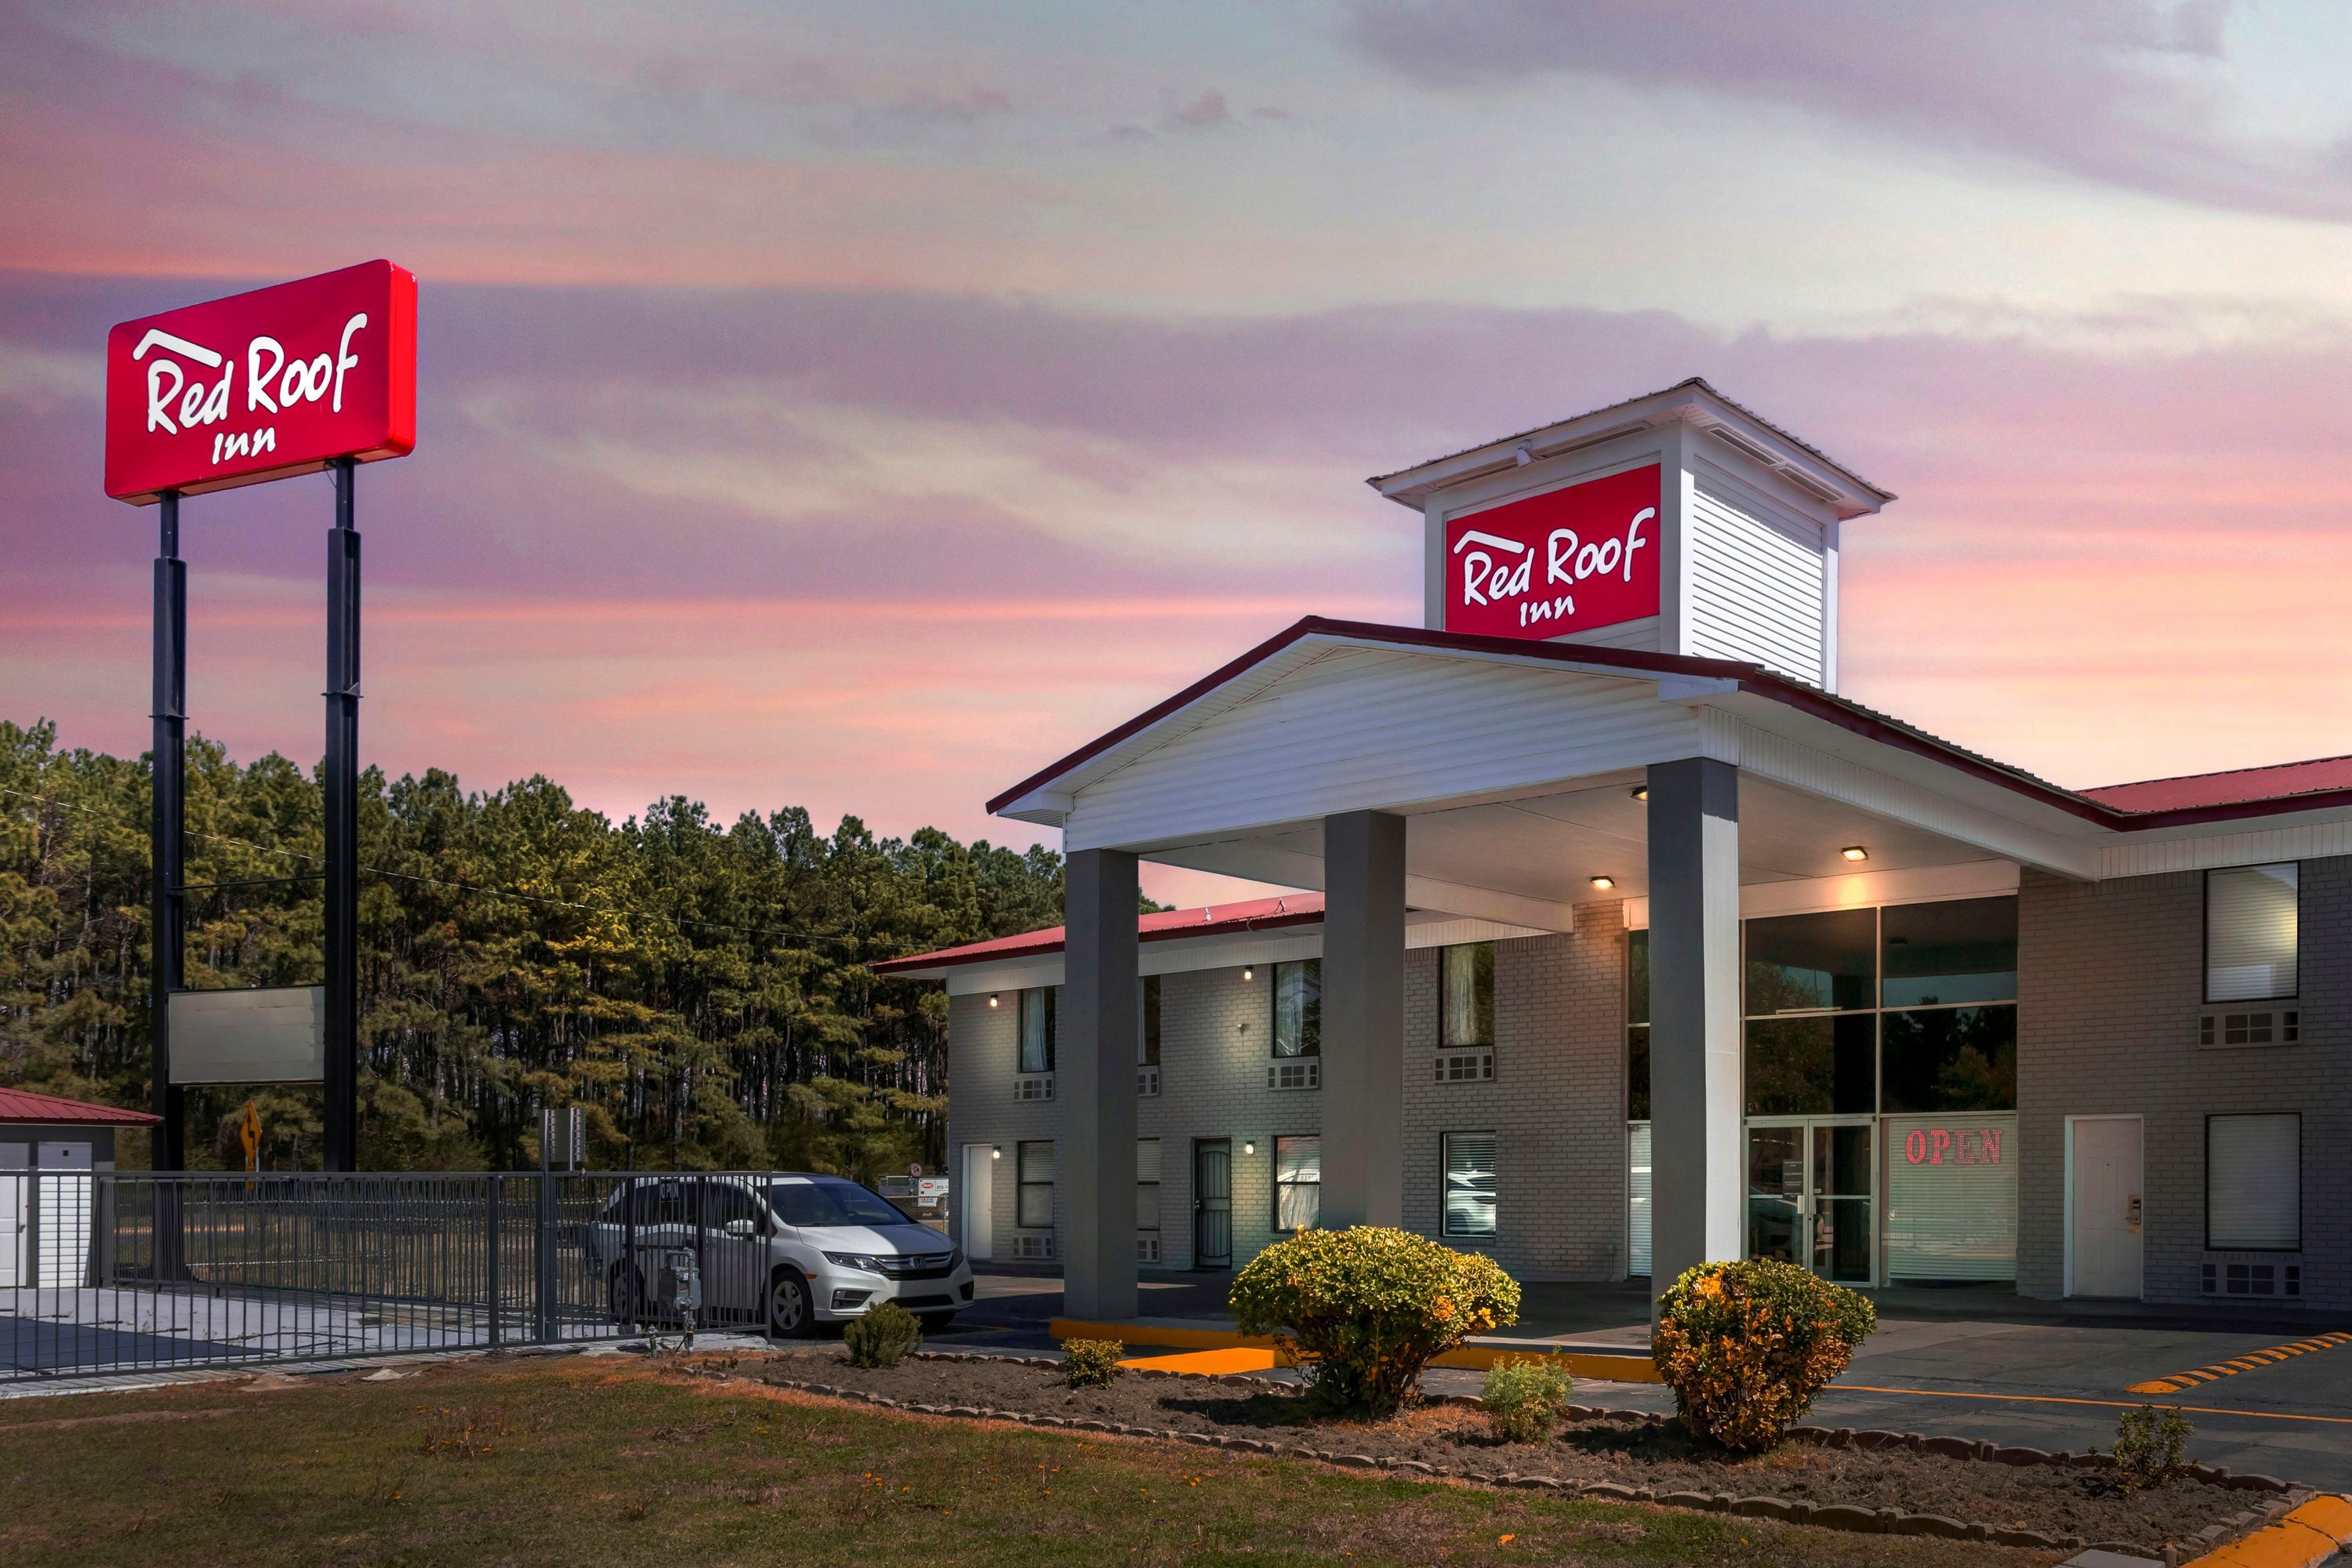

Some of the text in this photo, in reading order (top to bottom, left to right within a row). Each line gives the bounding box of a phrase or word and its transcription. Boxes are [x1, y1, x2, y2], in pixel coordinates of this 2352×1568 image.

[147, 313, 368, 435] Red Roof
[1464, 506, 1656, 606] Red Roof
[1906, 1129, 2002, 1165] OPEN
